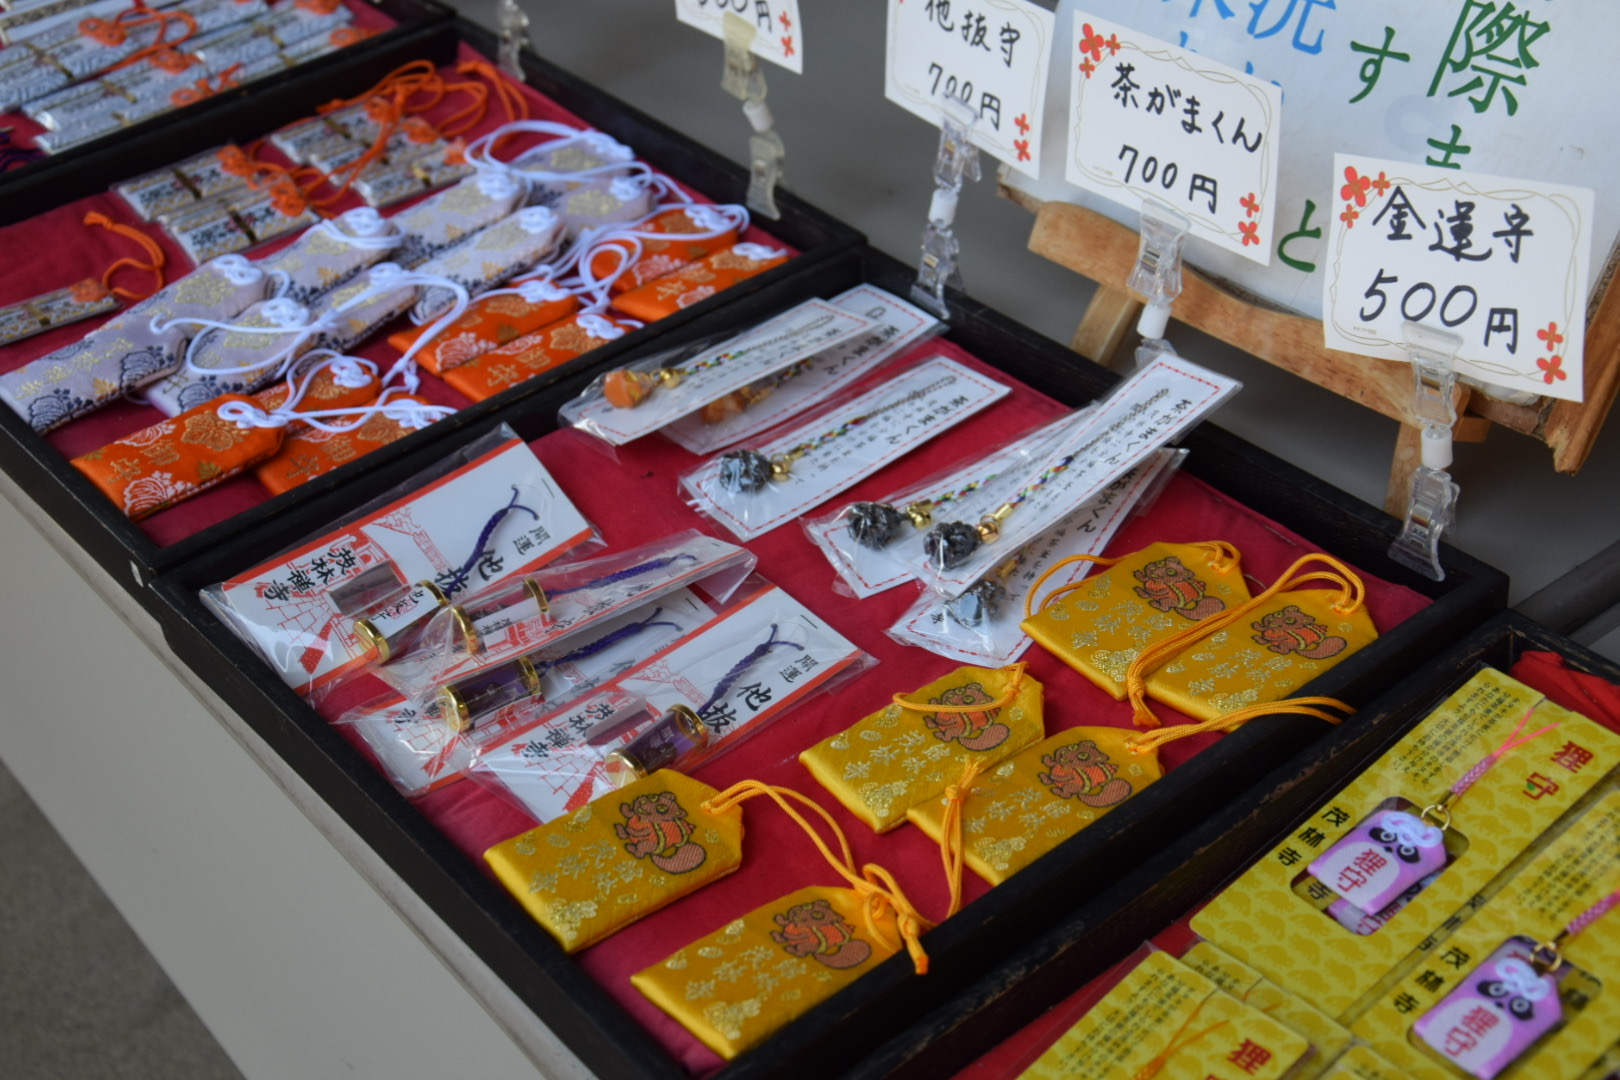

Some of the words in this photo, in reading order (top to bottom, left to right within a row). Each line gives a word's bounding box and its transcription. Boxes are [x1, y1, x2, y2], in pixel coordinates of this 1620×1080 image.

[925, 0, 1021, 68] 他抜守
[1348, 26, 1411, 104] す
[928, 62, 1001, 131] 700円
[1110, 61, 1263, 154] 茶がまくん
[1118, 144, 1218, 215] 700円
[1277, 199, 1321, 273] と
[1372, 185, 1534, 264] 金運守
[1359, 268, 1520, 355] 500円
[1104, 398, 1193, 465] 茶がまくん
[512, 525, 552, 556] 開運
[1522, 739, 1595, 801] 狸守
[1276, 806, 1351, 868] 茂林寺
[1336, 848, 1388, 893] 狸守
[1393, 946, 1471, 1014] 茂林寺
